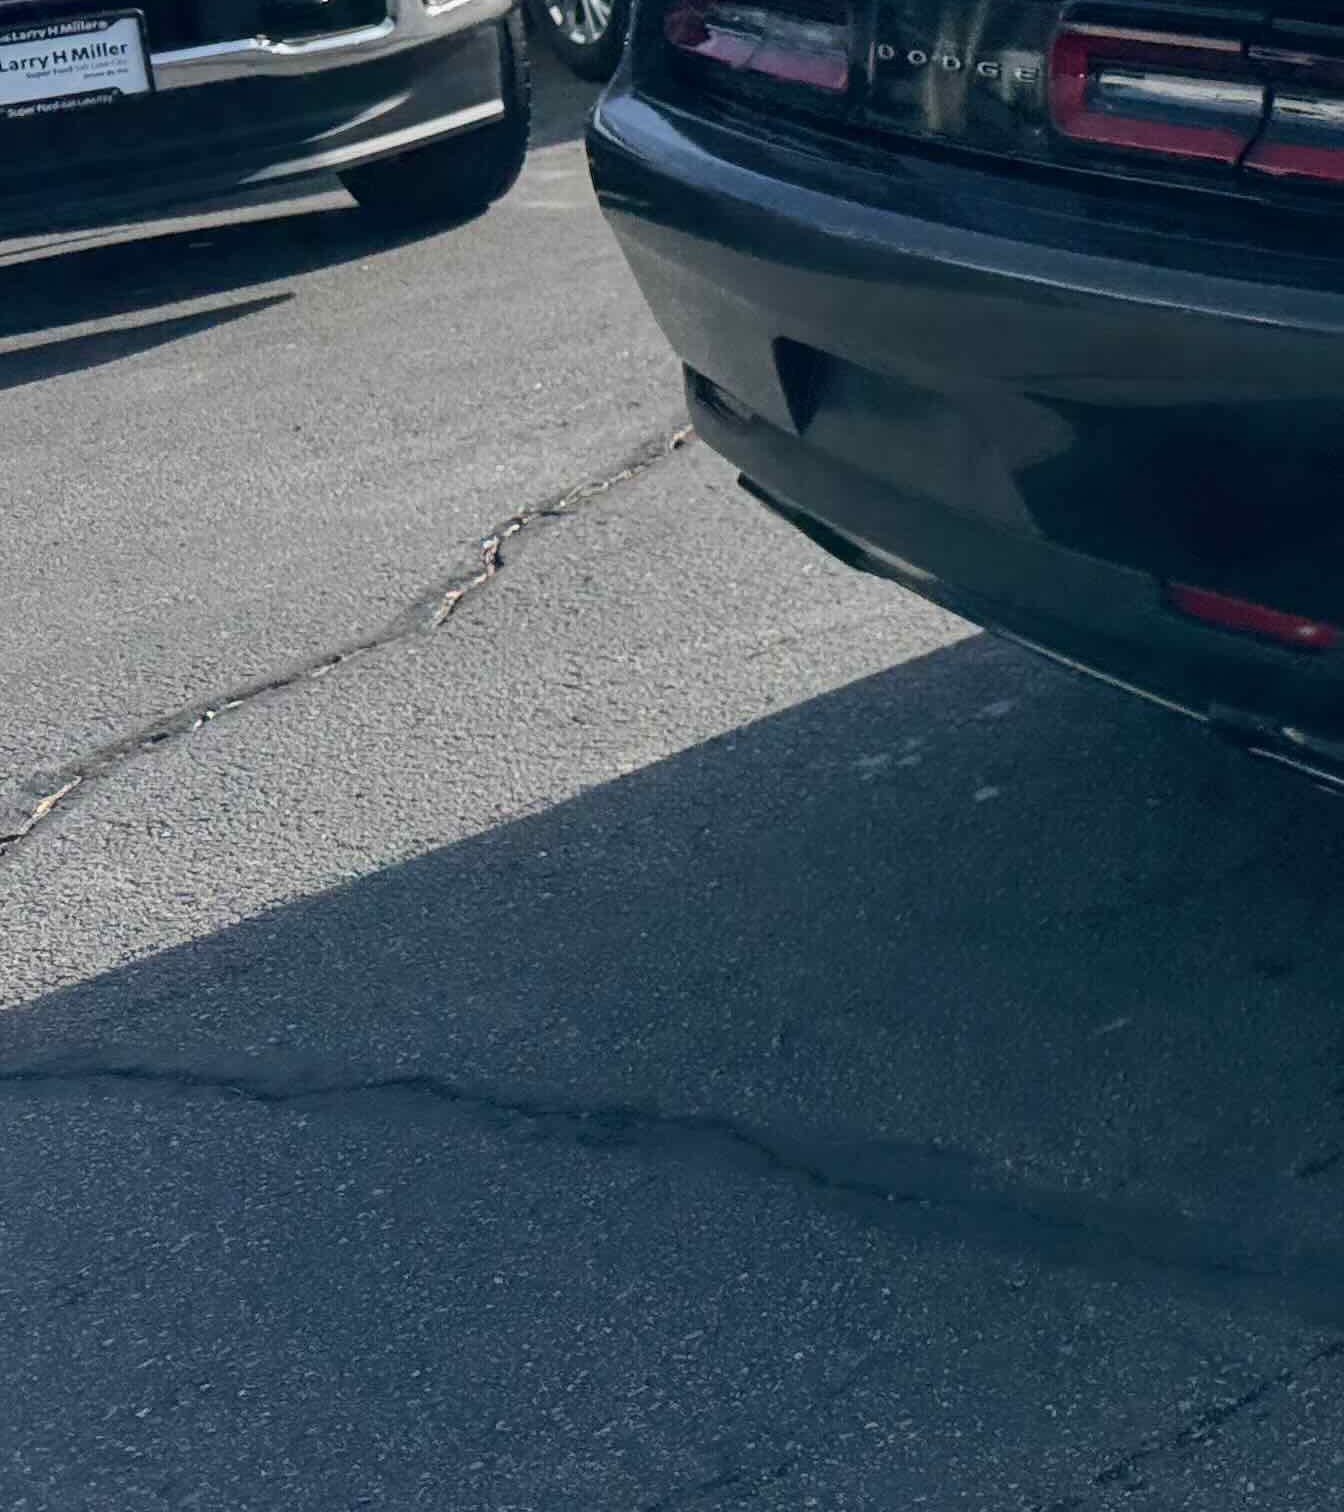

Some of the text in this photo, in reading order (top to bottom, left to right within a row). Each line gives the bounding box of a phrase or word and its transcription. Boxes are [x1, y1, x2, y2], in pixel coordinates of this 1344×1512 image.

[47, 25, 59, 37] H
[52, 50, 68, 65] H
[71, 42, 129, 62] Miller
[878, 43, 1040, 84] DODGE
